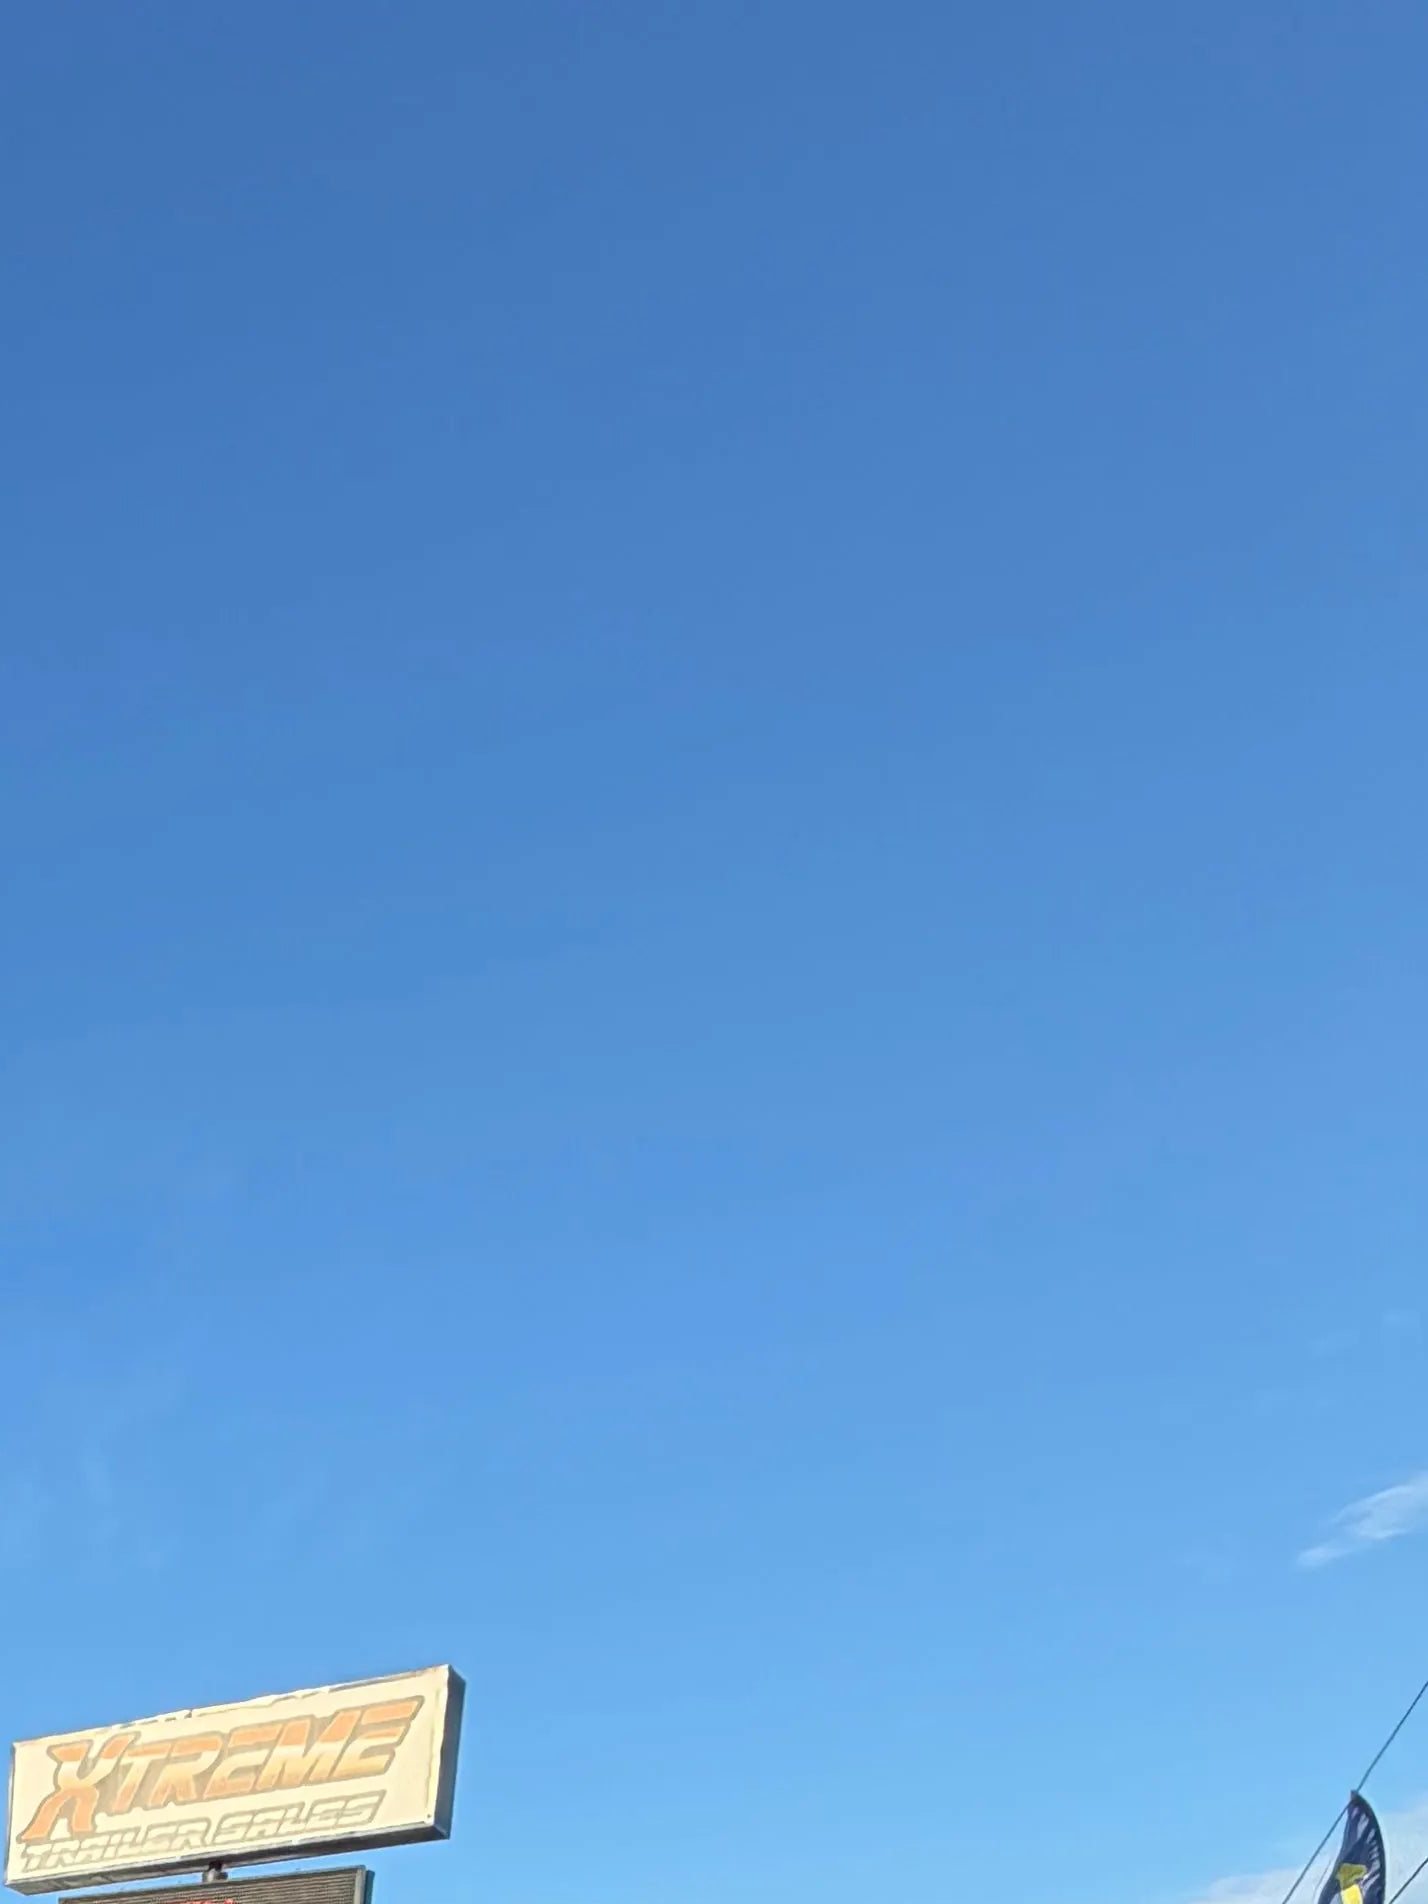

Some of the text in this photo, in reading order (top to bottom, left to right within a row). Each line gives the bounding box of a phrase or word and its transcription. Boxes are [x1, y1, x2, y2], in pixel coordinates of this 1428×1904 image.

[17, 1695, 424, 1843] XTREME
[23, 1790, 386, 1871] TRAILER SALES
